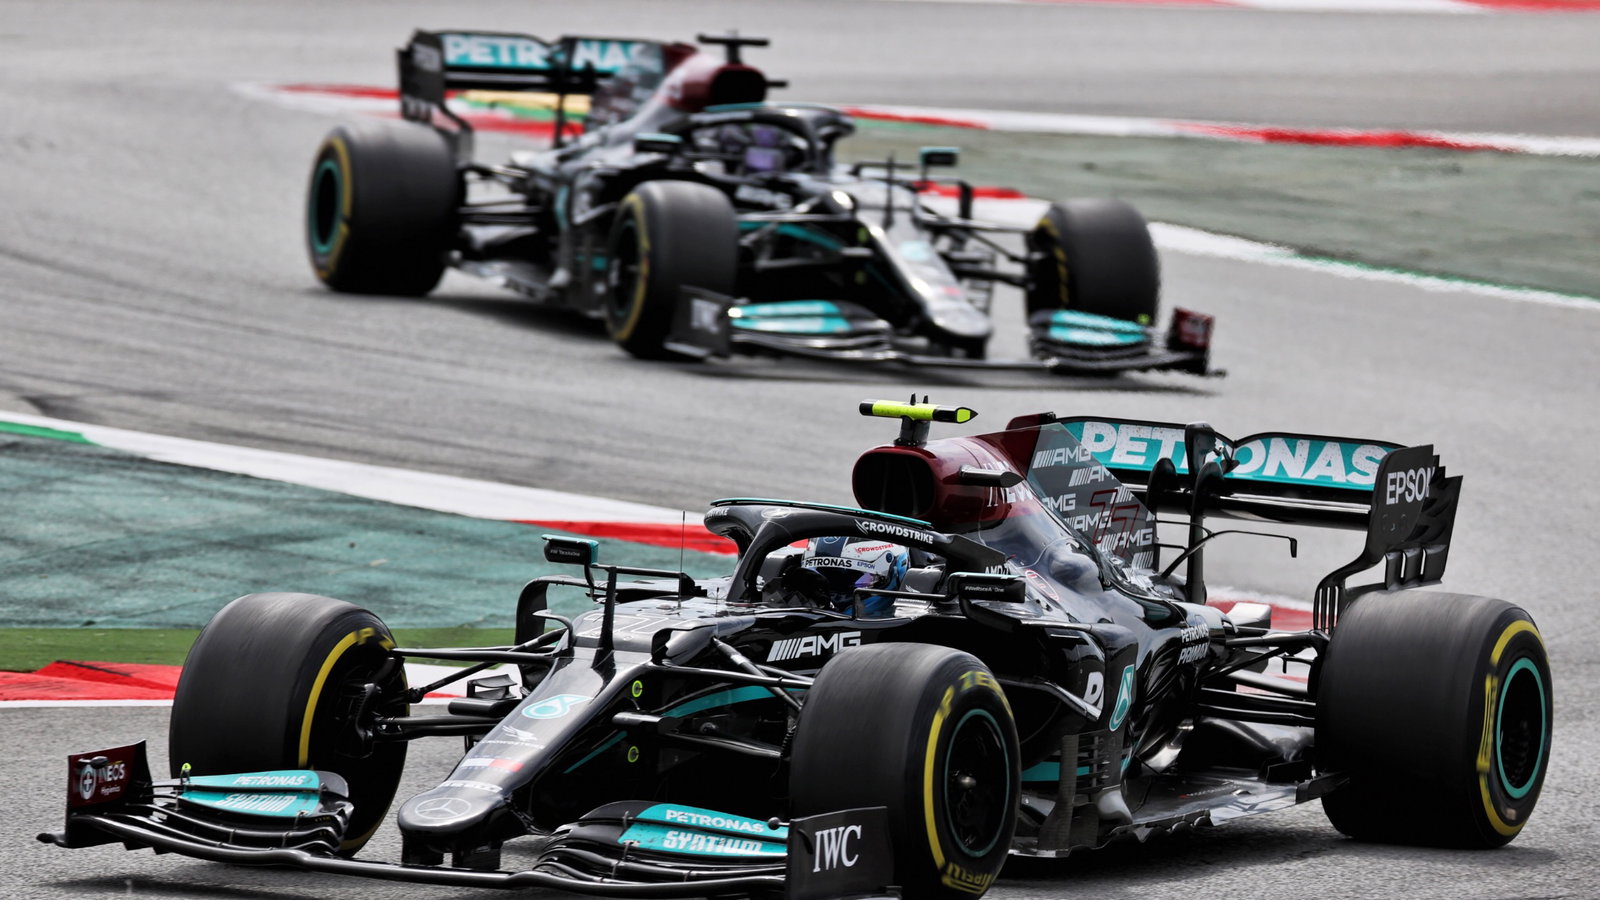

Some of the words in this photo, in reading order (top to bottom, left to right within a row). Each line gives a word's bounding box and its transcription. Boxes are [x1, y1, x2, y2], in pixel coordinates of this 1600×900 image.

[444, 34, 655, 74] PETRNA
[1051, 446, 1091, 467] AMG
[1073, 510, 1113, 532] AMG
[860, 520, 934, 545] CROWDSTRIKE
[1112, 527, 1153, 551] AMG
[805, 557, 853, 568] PETRONAS
[857, 561, 876, 570] EPSON
[1180, 622, 1210, 644] PETRONAS
[795, 631, 862, 659] AMG
[98, 763, 126, 783] NEOS
[232, 775, 307, 786] PETRONAS
[665, 809, 766, 834] PETRONAS
[813, 825, 862, 873] IWC
